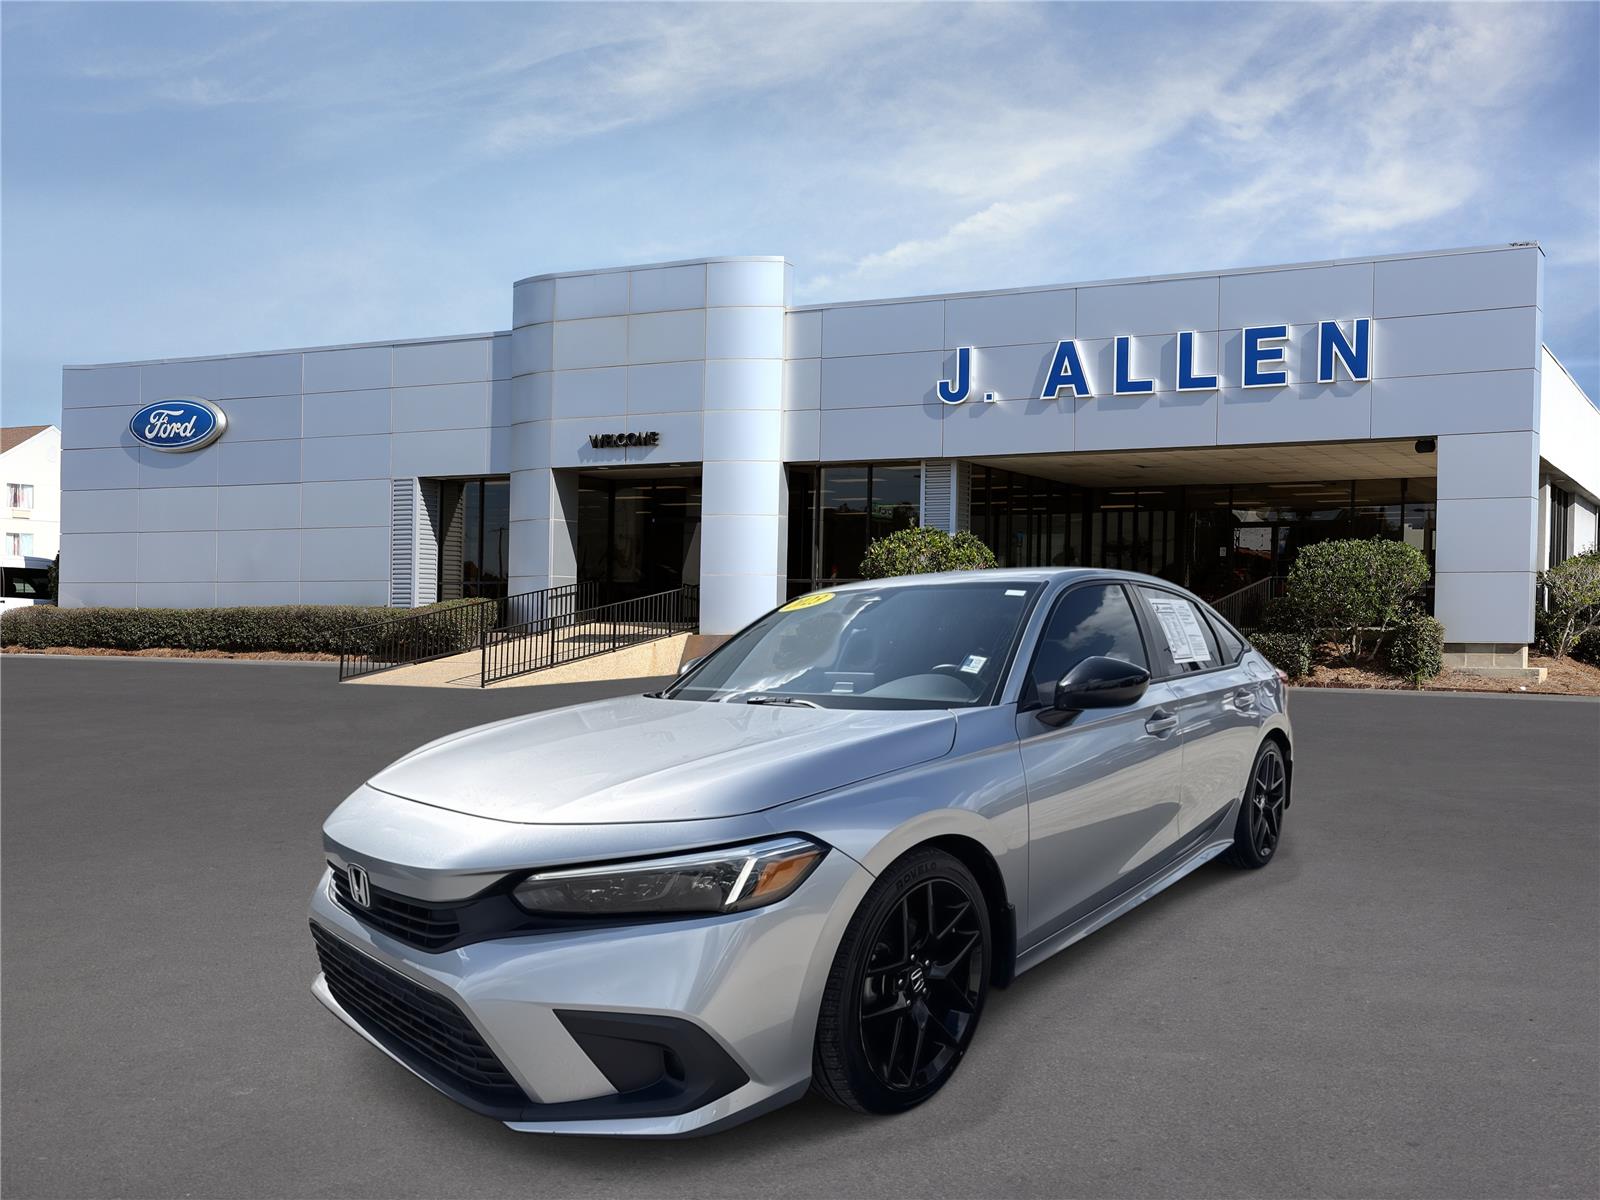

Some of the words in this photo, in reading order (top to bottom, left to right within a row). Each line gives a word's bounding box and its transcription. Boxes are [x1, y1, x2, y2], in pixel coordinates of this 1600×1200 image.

[937, 345, 996, 404] J.
[1039, 317, 1372, 399] ALLEN
[144, 409, 197, 439] Ford
